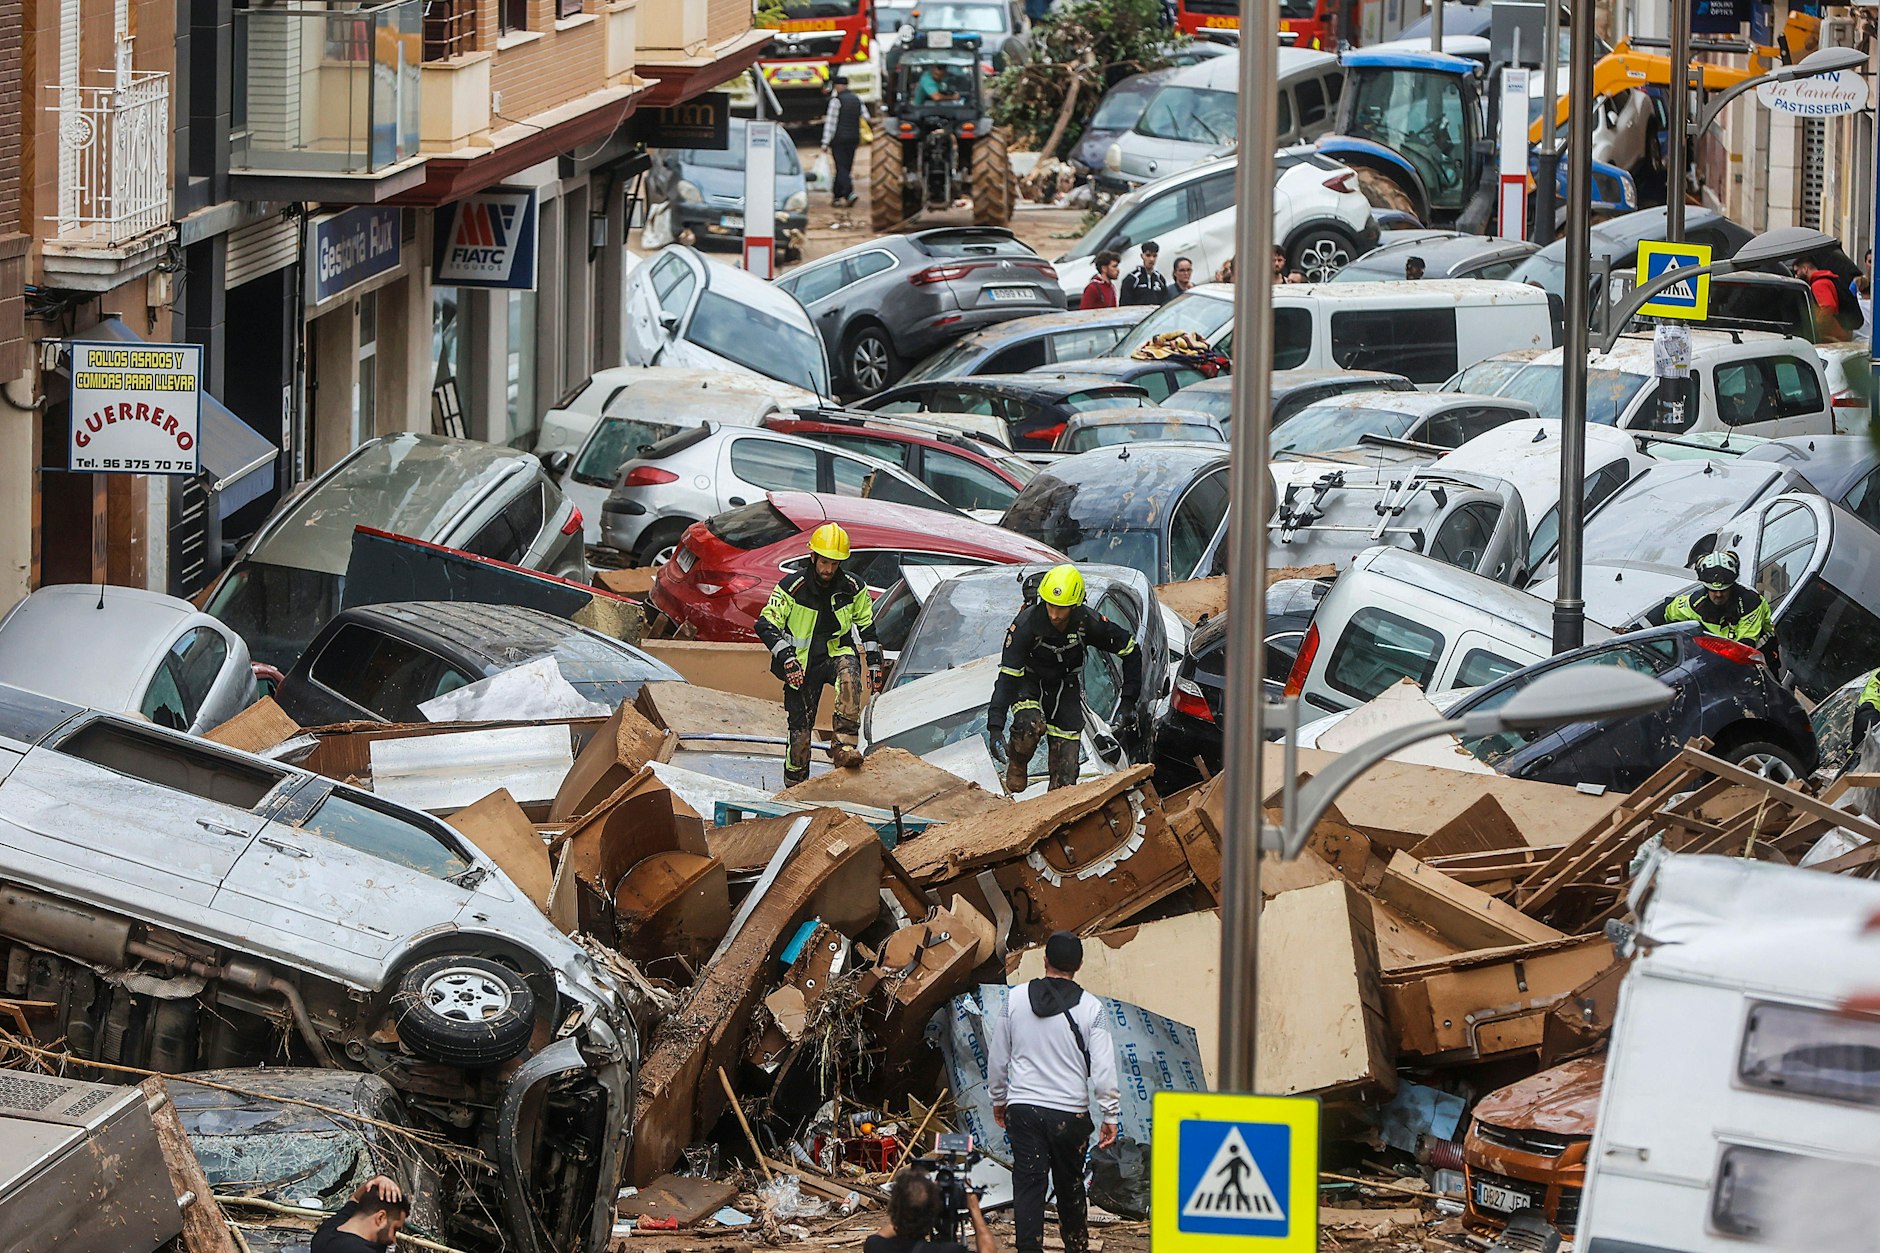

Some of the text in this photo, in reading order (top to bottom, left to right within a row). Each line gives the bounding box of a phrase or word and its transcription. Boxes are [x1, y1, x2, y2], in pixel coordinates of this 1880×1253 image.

[1774, 98, 1851, 115] PASTISSERIA
[452, 248, 504, 264] FIATC
[450, 263, 502, 271] SEGUROS
[88, 350, 185, 369] POLLOS ASADOS Y
[76, 372, 195, 391] COMIDAS PARA LLEVAR
[75, 402, 194, 451] GUERRERO
[76, 458, 193, 470] Tel. 96 375 70 76
